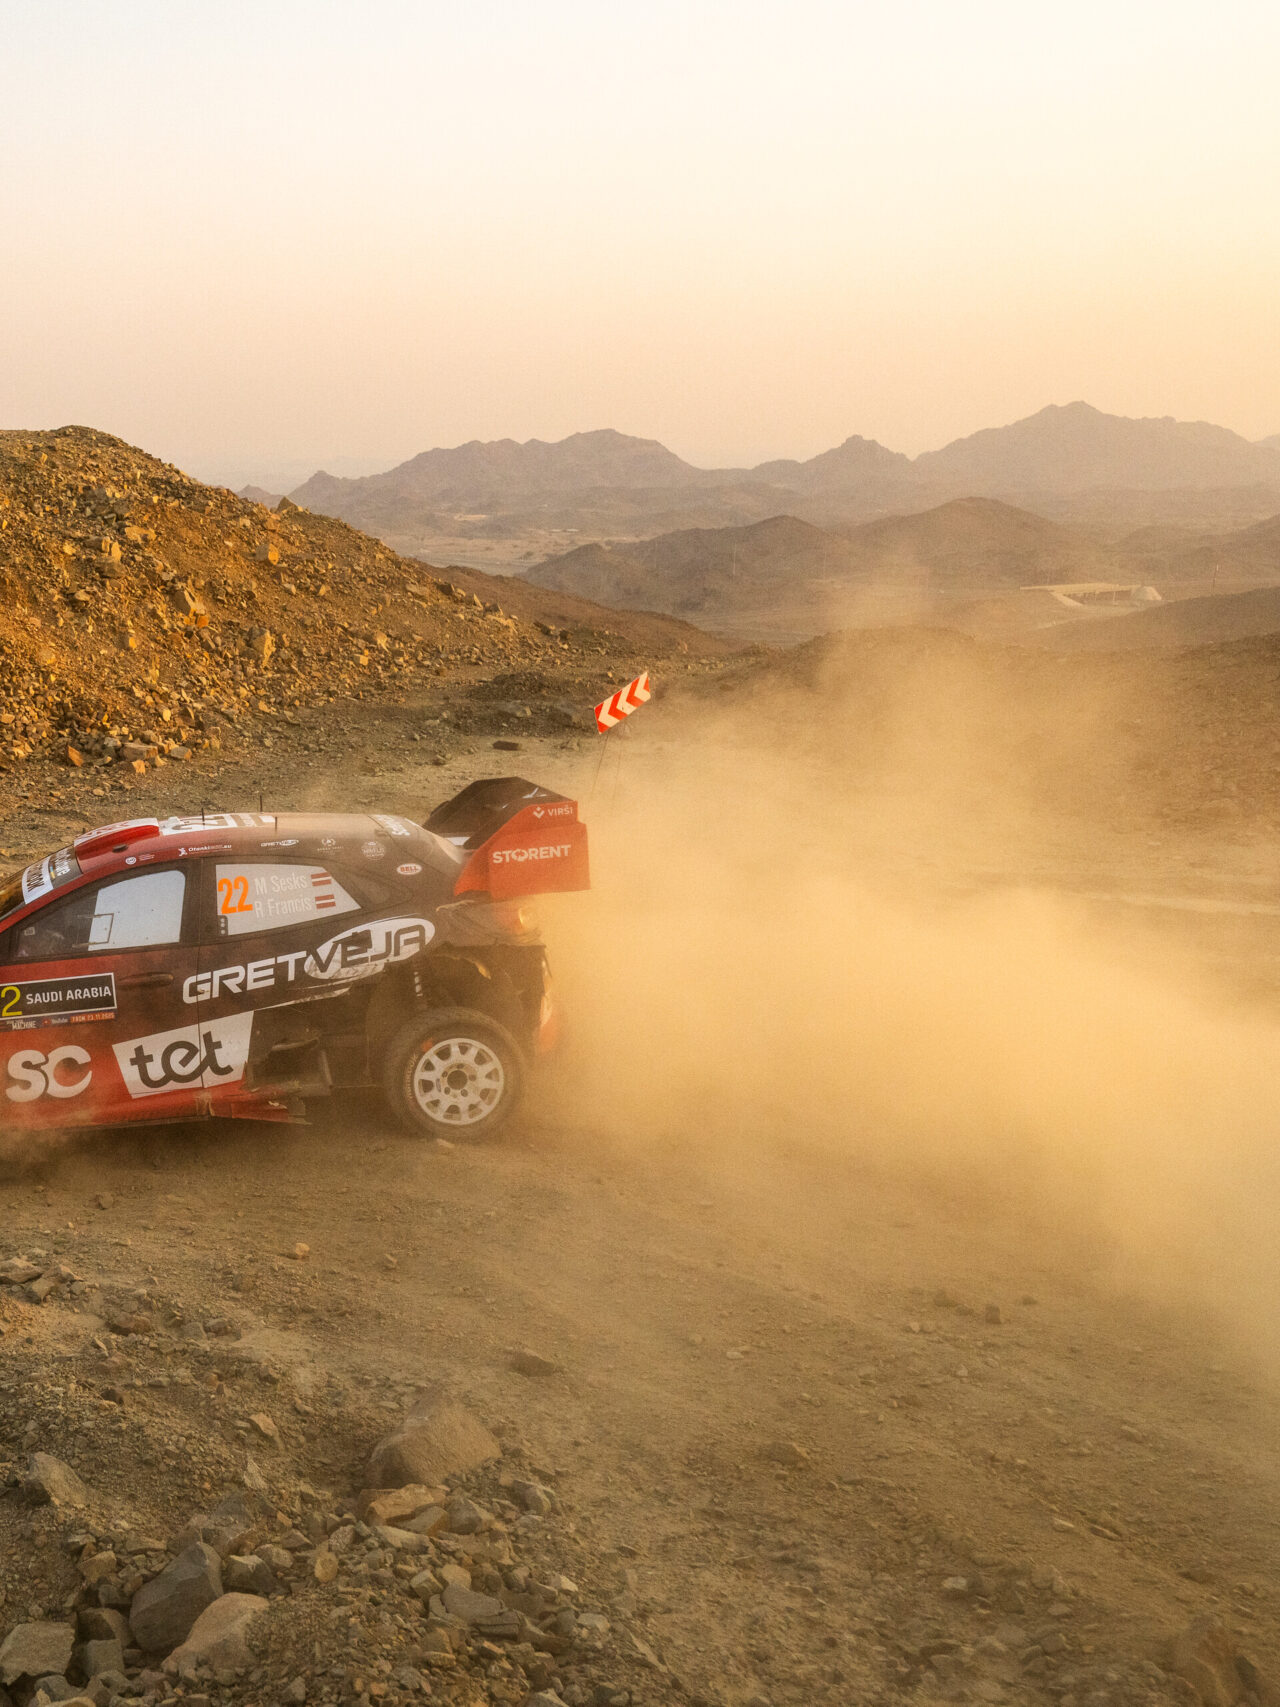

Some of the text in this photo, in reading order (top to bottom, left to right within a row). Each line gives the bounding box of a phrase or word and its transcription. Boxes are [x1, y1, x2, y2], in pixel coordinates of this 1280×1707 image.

[547, 805, 573, 817] VIRŠI
[492, 845, 571, 864] STORENT
[218, 875, 253, 915] 22
[254, 873, 308, 896] M Sesks
[254, 897, 313, 919] R Francis
[25, 986, 112, 1005] SAUDI ARABIA
[129, 1030, 233, 1088] tet
[5, 1044, 92, 1101] SC
